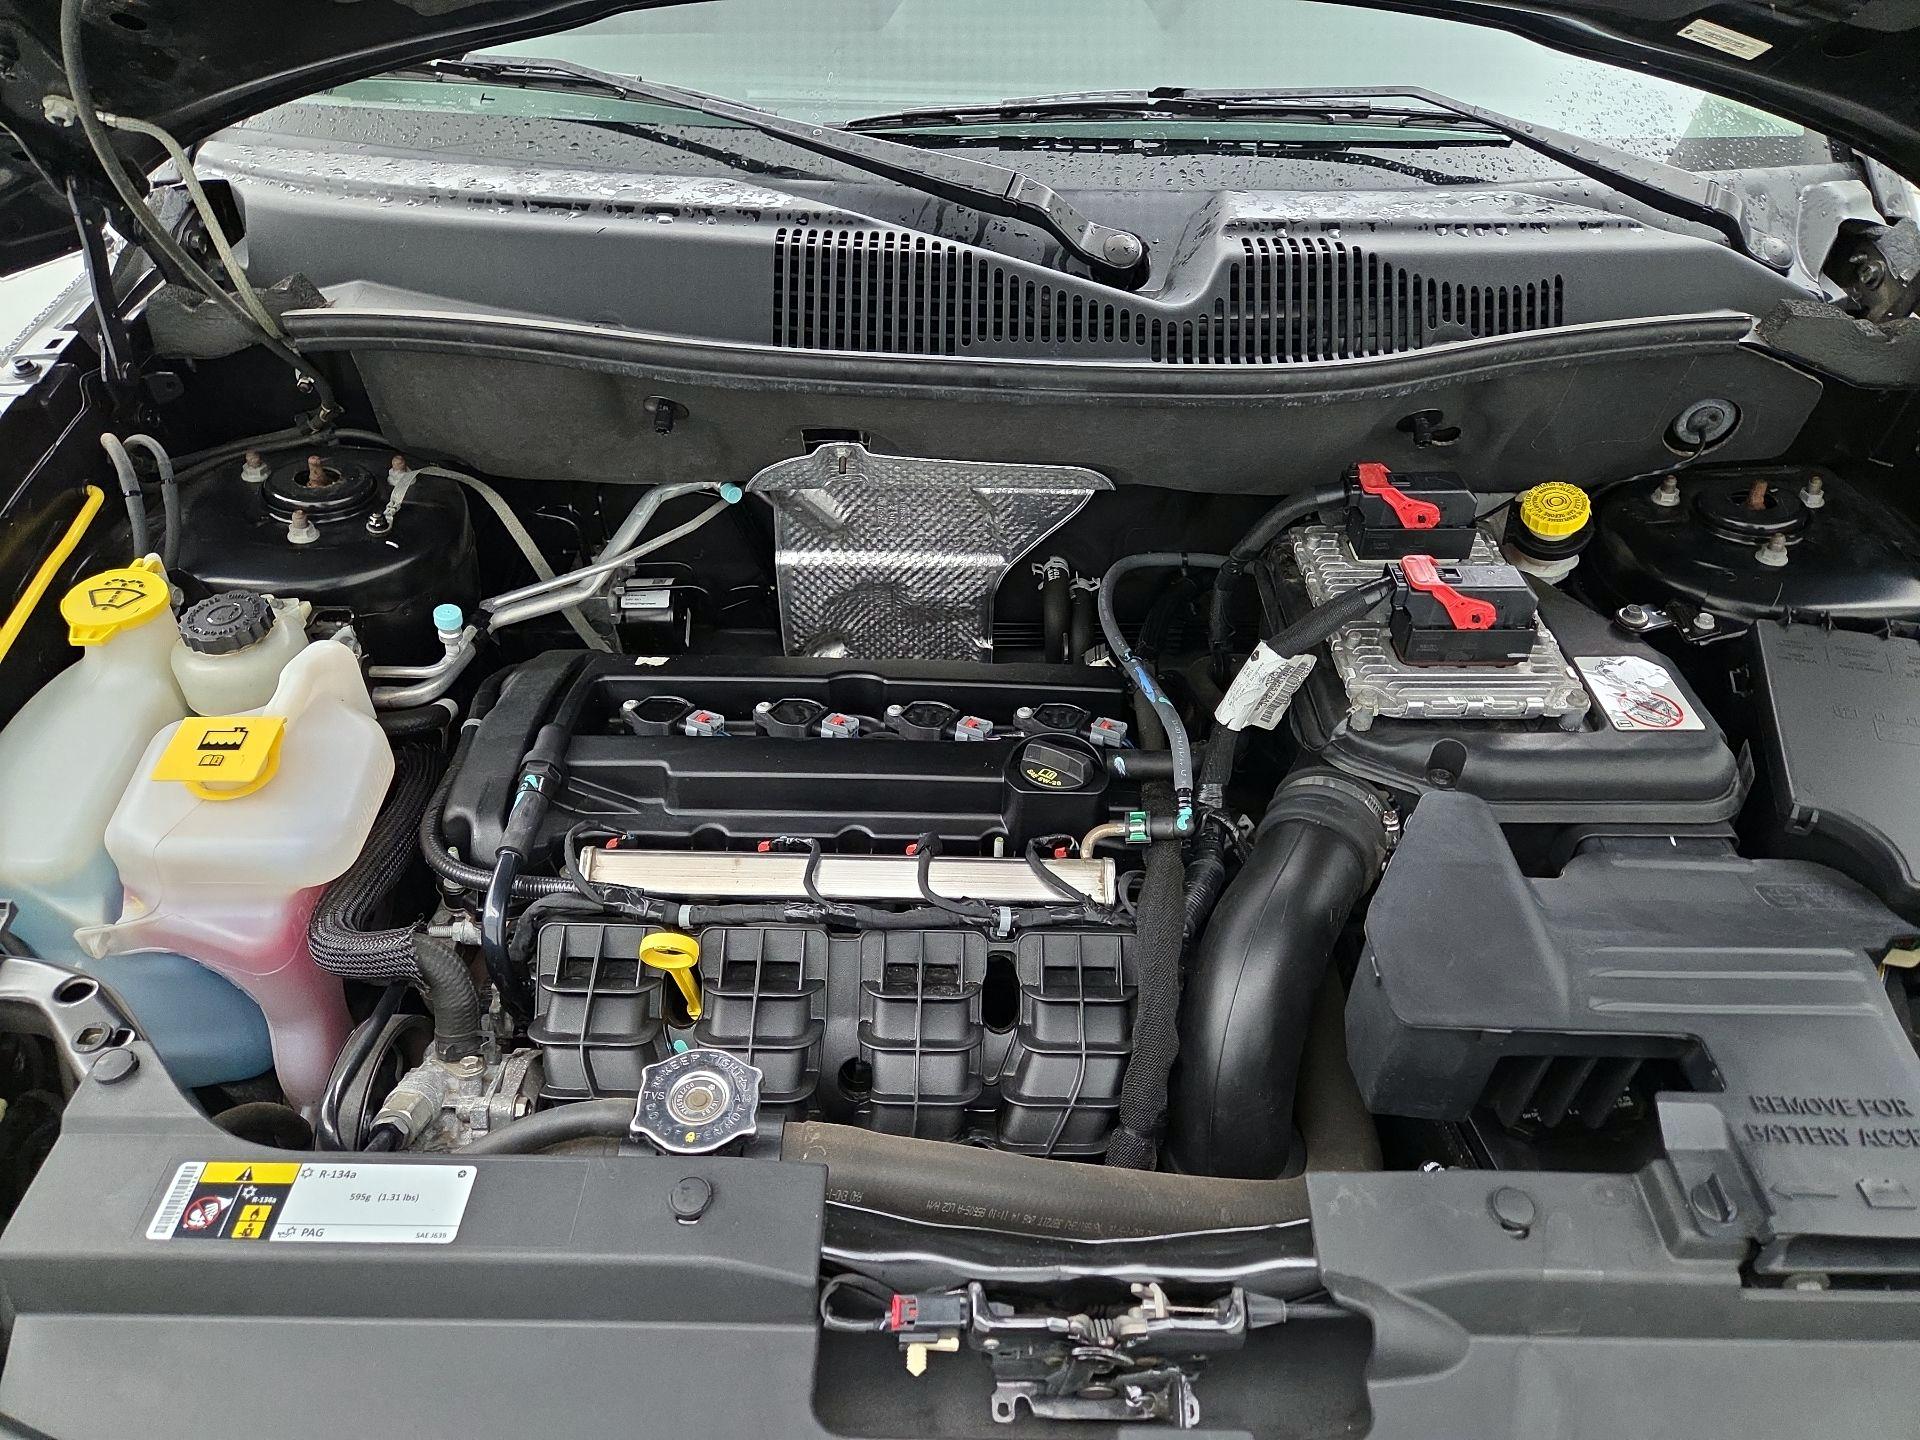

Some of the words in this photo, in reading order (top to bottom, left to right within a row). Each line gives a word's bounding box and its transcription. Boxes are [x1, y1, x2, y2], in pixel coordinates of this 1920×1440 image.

[663, 1053, 700, 1076] KEEP
[644, 1090, 665, 1100] TVS
[1748, 1094, 1857, 1117] REMOVE
[1857, 1098, 1914, 1118] FOR
[1744, 1122, 1850, 1147] BATTERY
[318, 1170, 357, 1179] R-134a
[350, 1193, 372, 1202] 595g
[378, 1193, 400, 1202] (1.31
[402, 1193, 420, 1202] lbs)
[301, 1228, 324, 1237] PAG
